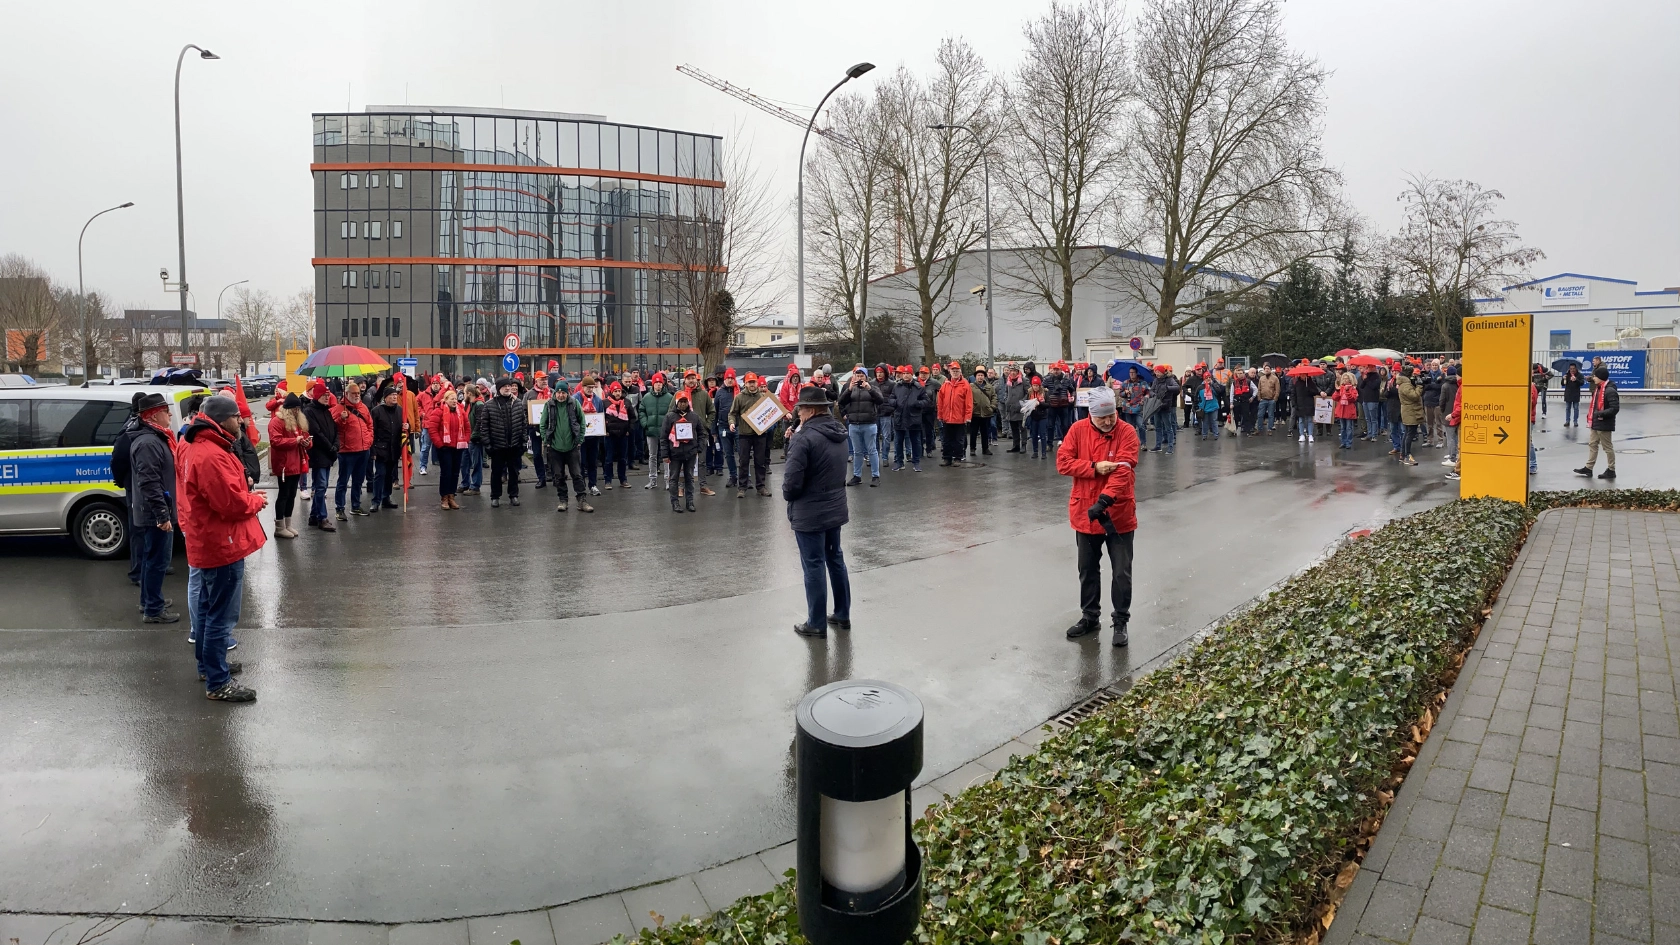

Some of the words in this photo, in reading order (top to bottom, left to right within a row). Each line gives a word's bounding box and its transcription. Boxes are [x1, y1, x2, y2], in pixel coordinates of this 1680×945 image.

[1465, 318, 1517, 333] Continental
[508, 338, 516, 347] 10
[1600, 355, 1633, 363] AUSTOFF
[1606, 362, 1630, 370] ETALL
[1463, 402, 1505, 412] Reception
[1463, 412, 1511, 423] Anmeldung
[0, 464, 19, 479] EI
[75, 467, 101, 476] Notruf
[103, 466, 113, 475] 11
